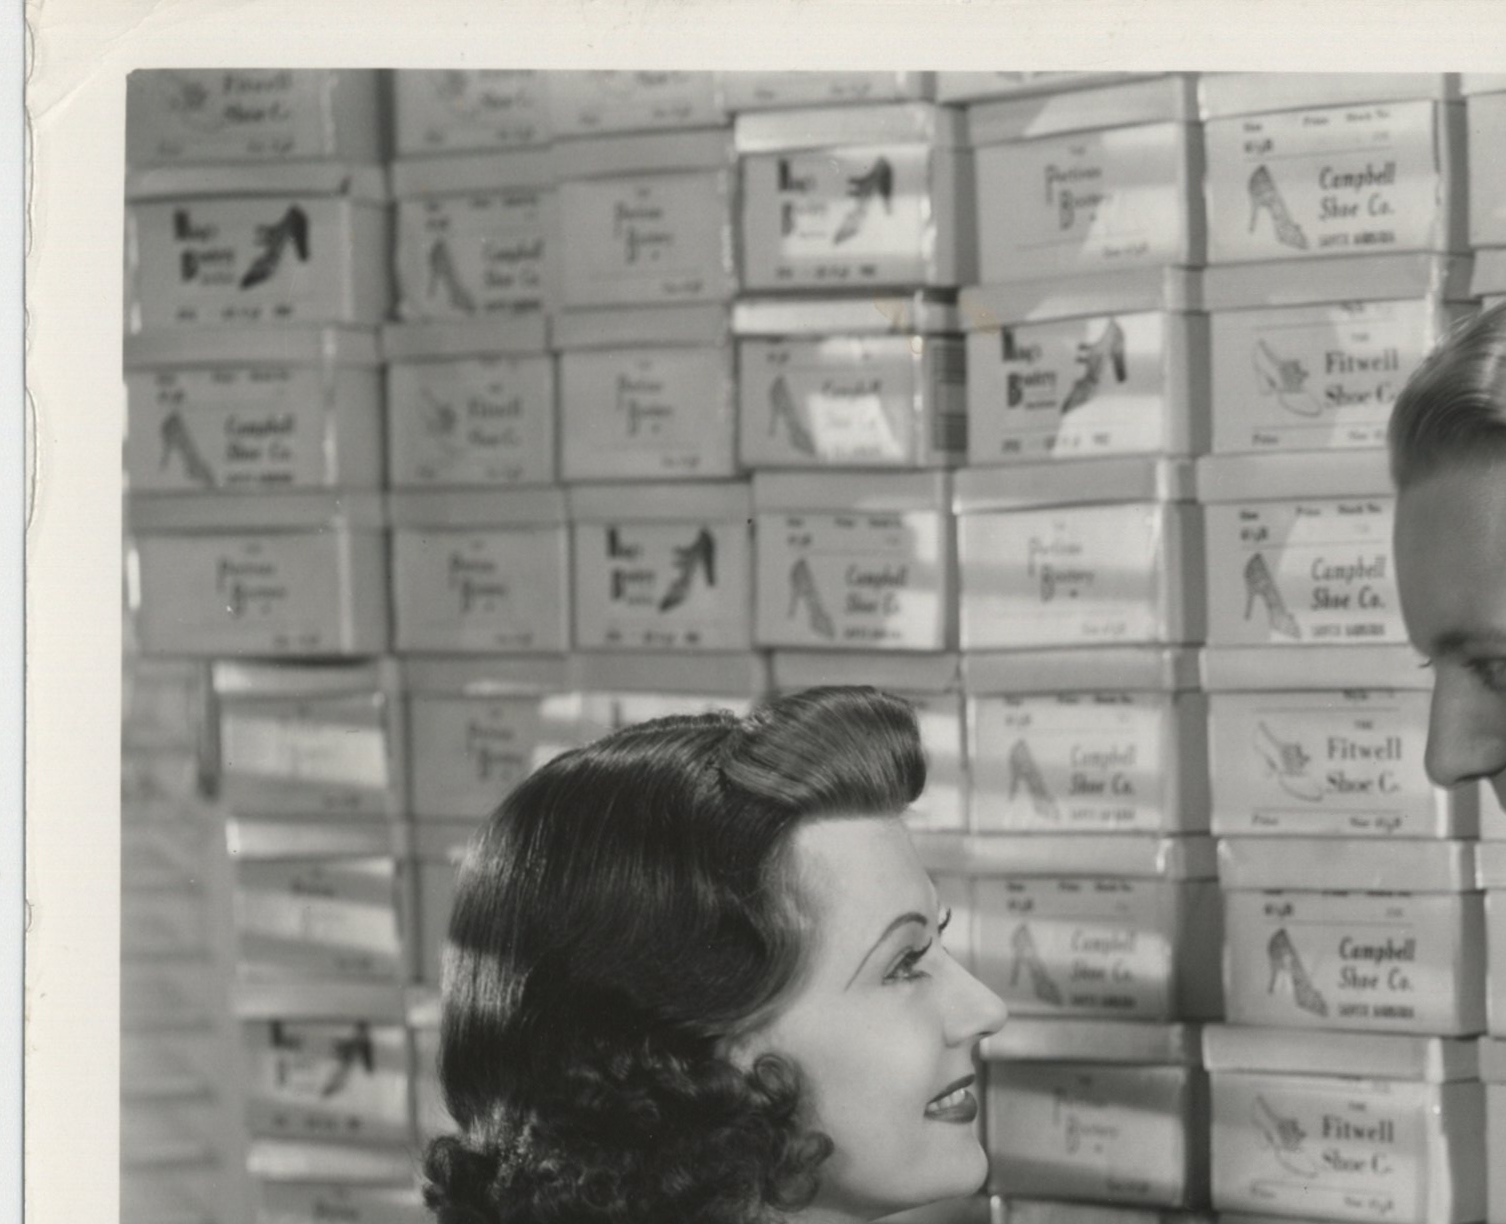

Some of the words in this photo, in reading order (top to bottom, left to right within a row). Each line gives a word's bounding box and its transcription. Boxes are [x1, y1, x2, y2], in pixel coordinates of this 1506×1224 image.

[1318, 160, 1397, 195] Campbell
[1318, 196, 1360, 222] Shoe
[1367, 193, 1395, 217] Co.
[1325, 349, 1399, 375] Fitwell
[1311, 556, 1387, 584] Campbell
[1311, 587, 1349, 612] Shoe
[1327, 736, 1402, 761] Fitwell
[1338, 936, 1416, 966] Campbell
[1338, 965, 1379, 990] Shoe
[1322, 1114, 1395, 1143] Fitwell
